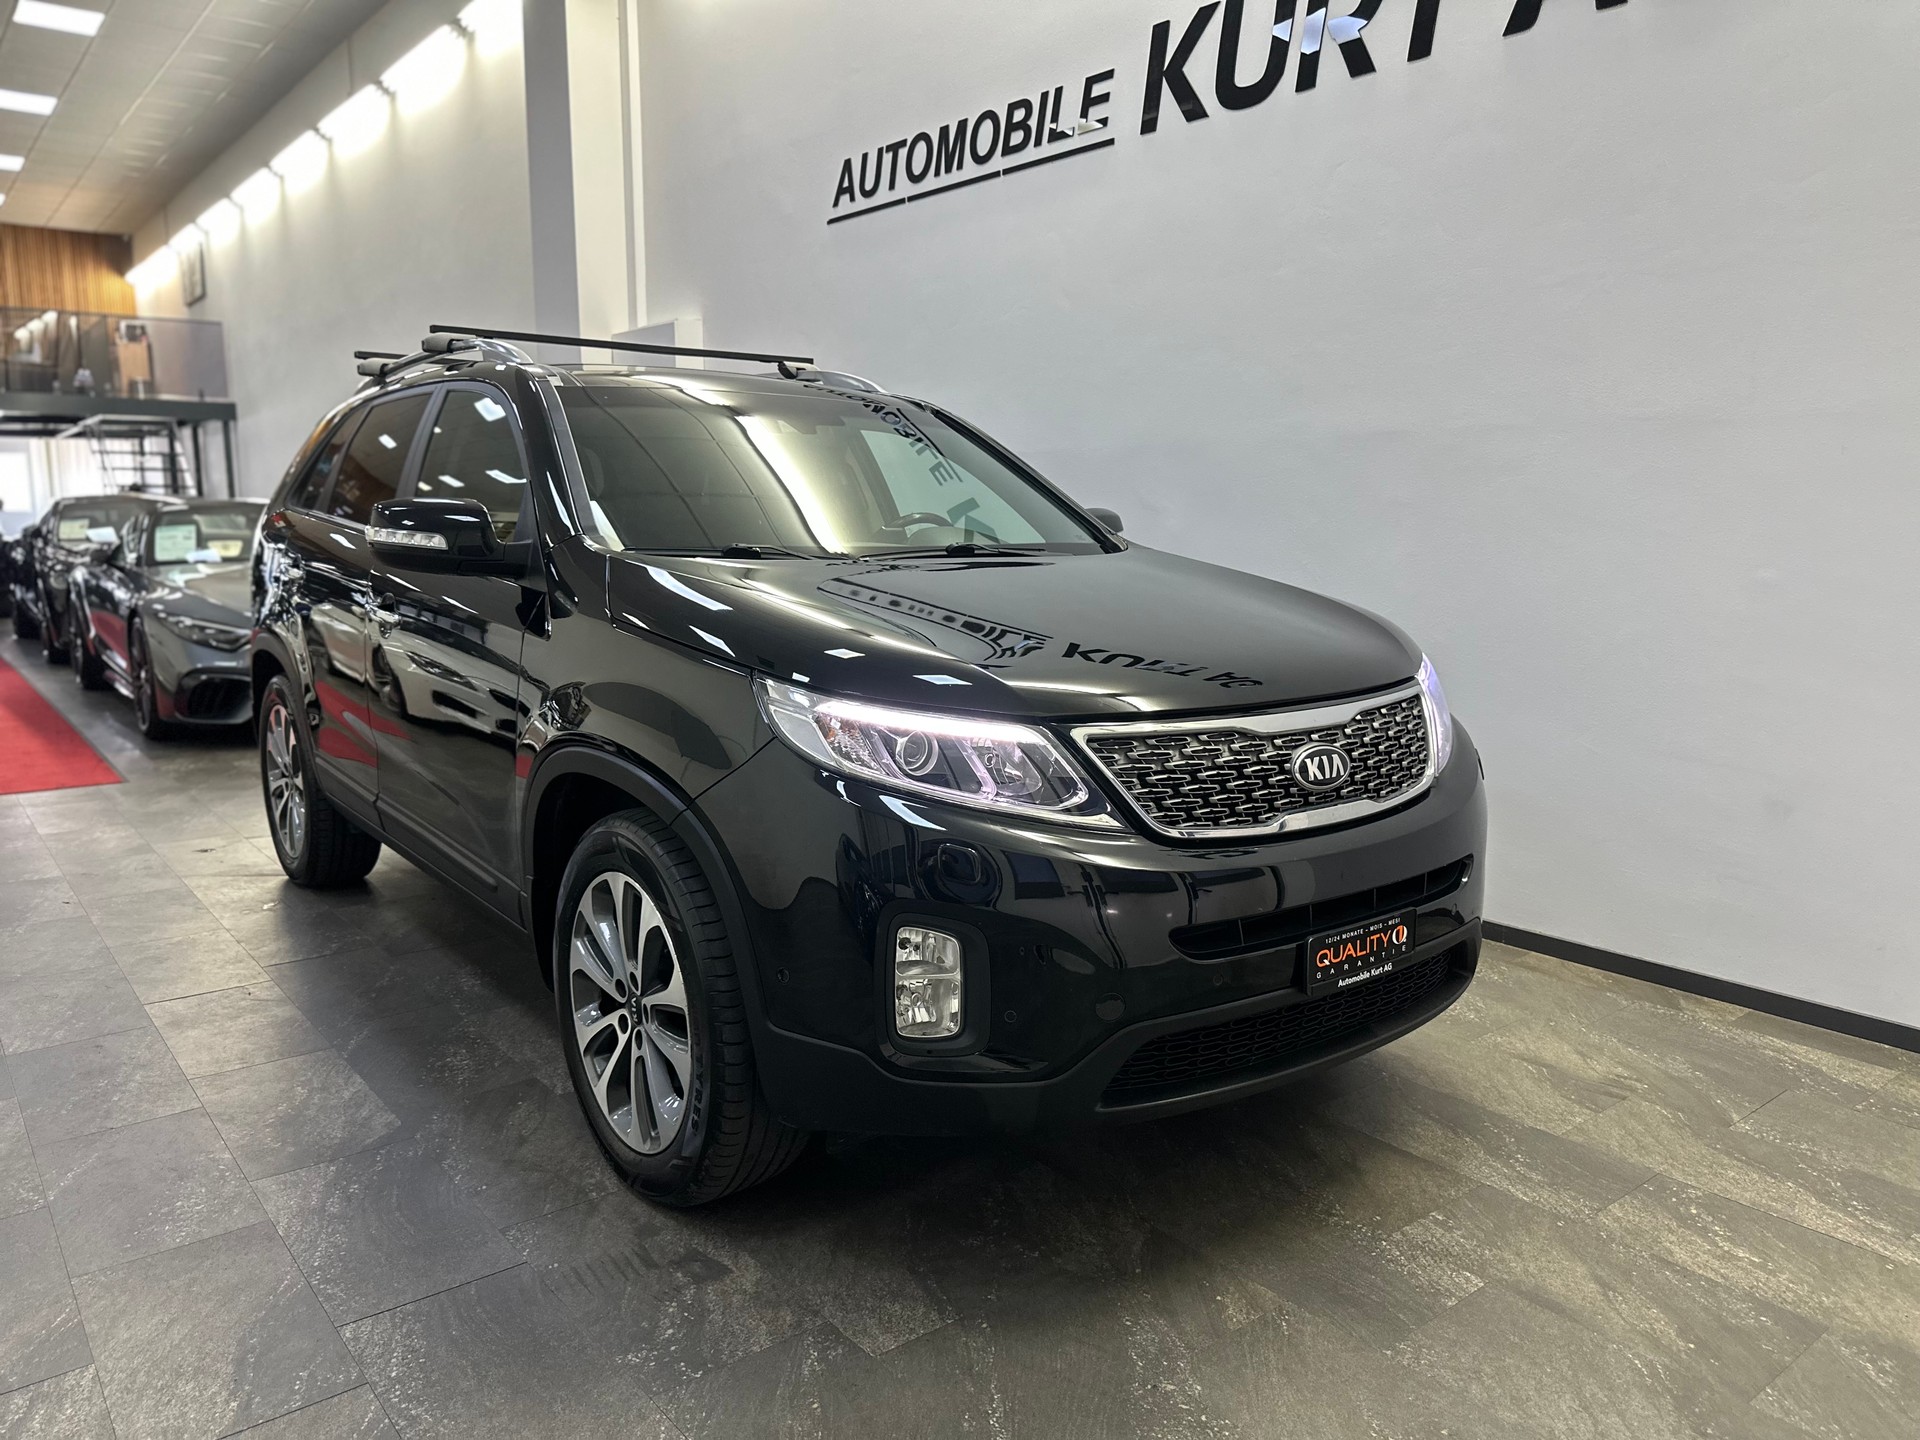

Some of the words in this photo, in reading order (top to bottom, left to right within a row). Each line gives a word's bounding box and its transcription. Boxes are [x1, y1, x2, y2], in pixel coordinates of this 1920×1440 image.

[832, 68, 1115, 208] AUTOMOBILE
[1304, 753, 1345, 782] KIA
[1316, 929, 1392, 968] QUALITY
[1325, 935, 1340, 944] 12/24
[1341, 928, 1364, 940] MONATE
[1369, 922, 1383, 932] MOIS
[1316, 944, 1407, 979] GARANTIE
[1337, 970, 1370, 988] Automobile
[1370, 965, 1384, 977] Kurt
[1383, 962, 1393, 972] AG
